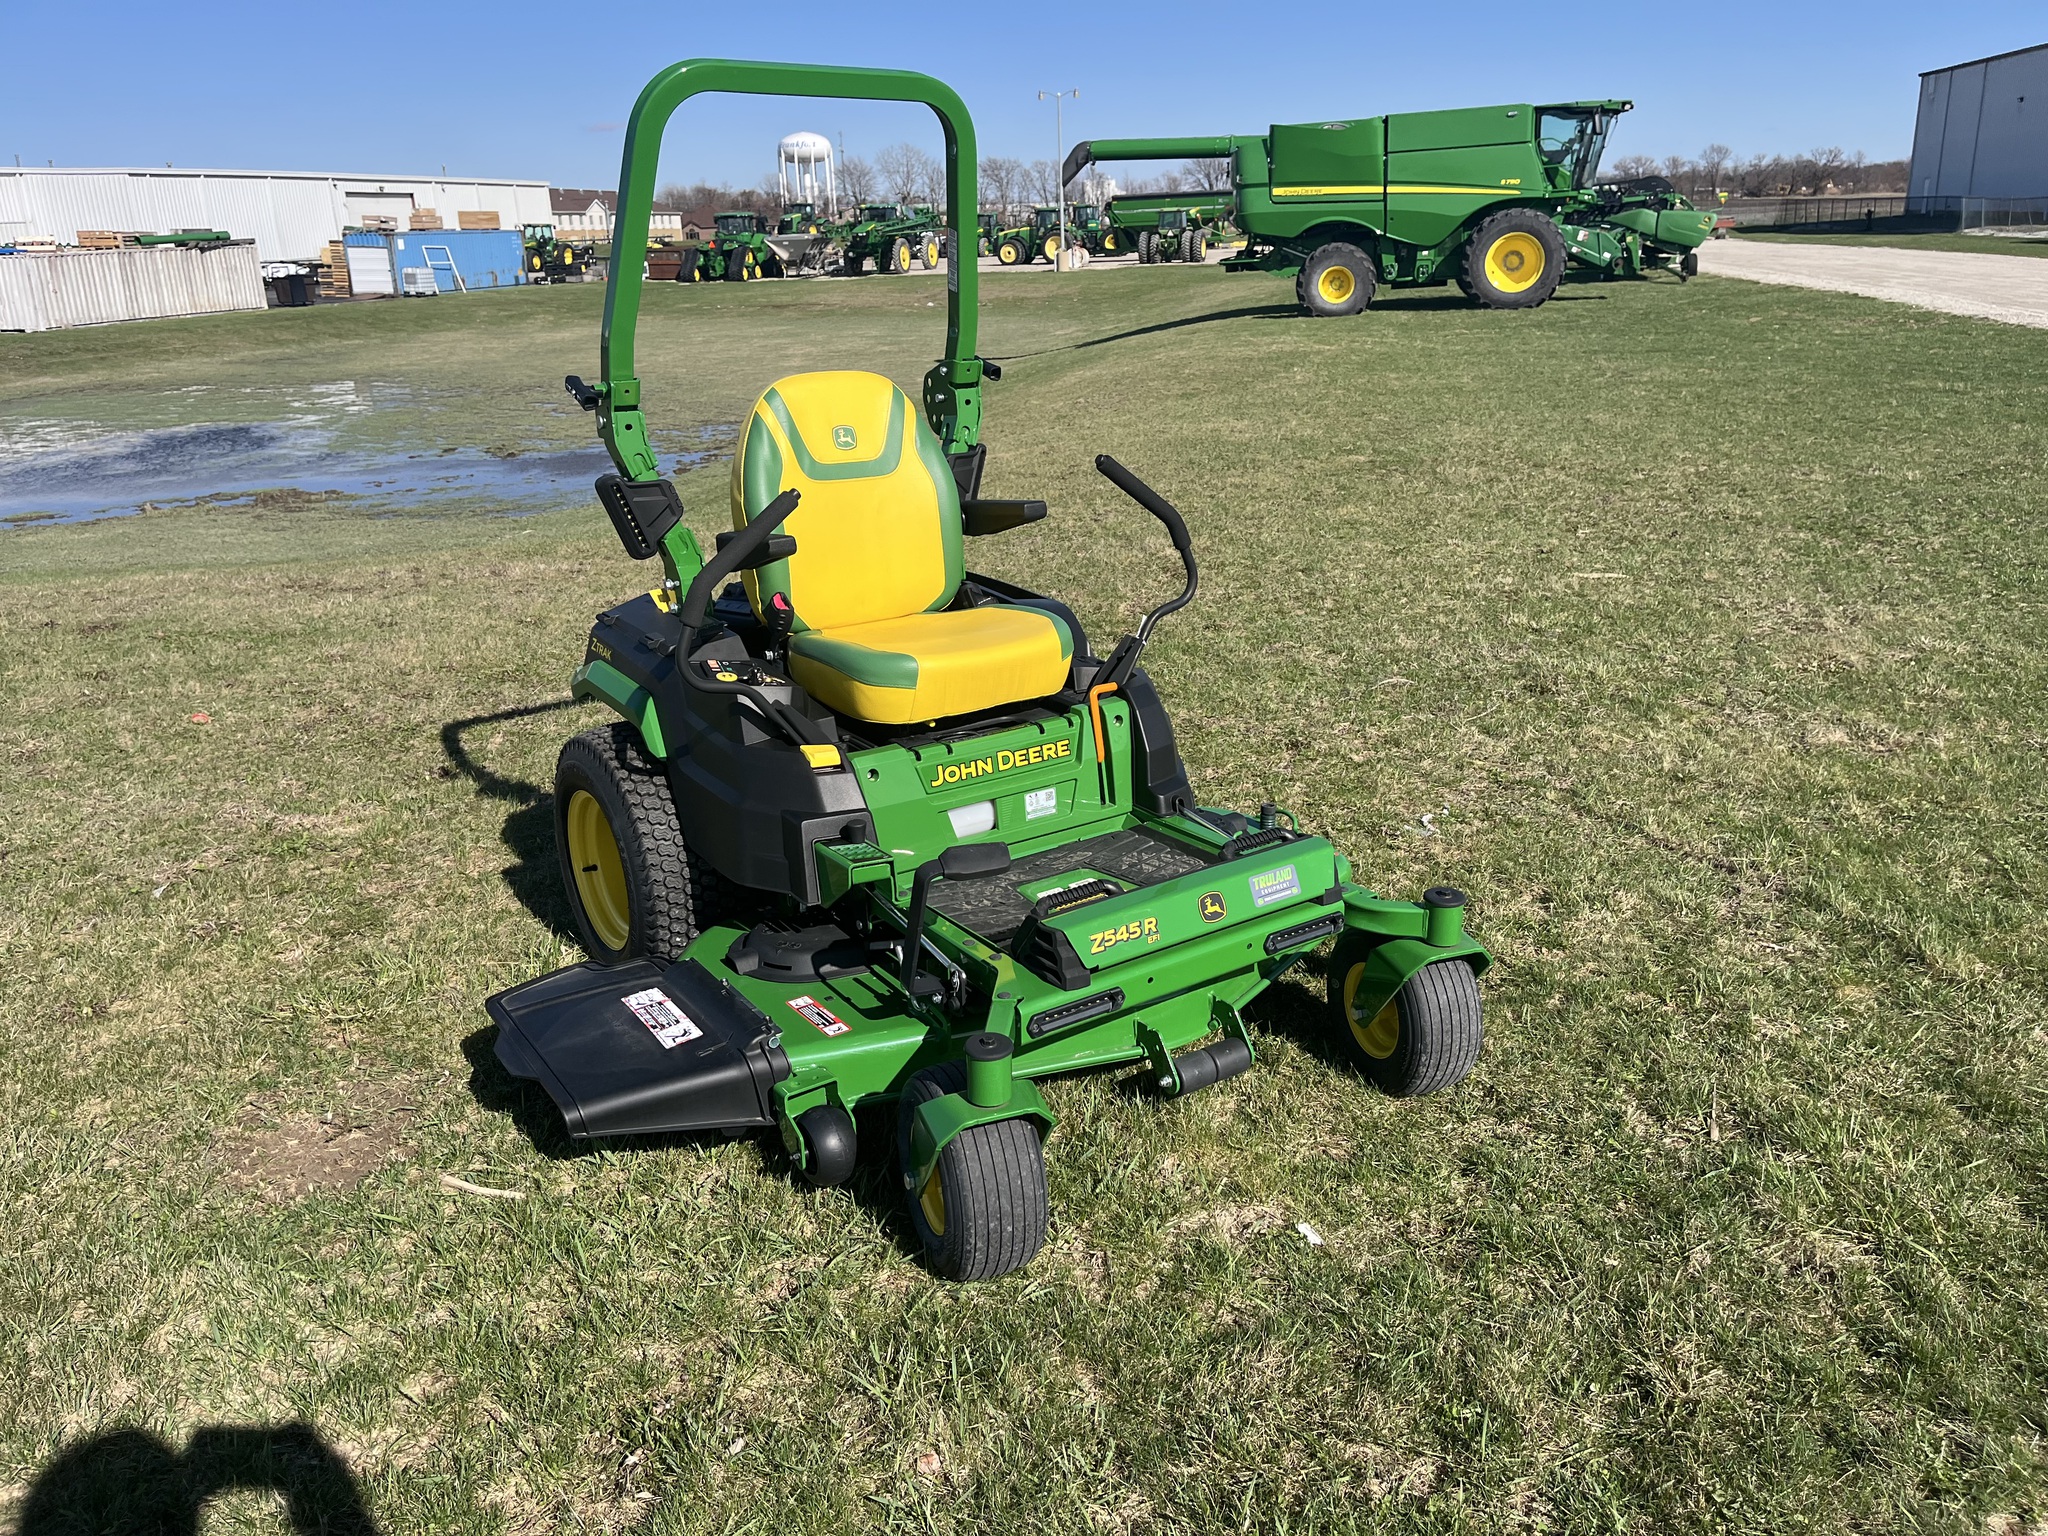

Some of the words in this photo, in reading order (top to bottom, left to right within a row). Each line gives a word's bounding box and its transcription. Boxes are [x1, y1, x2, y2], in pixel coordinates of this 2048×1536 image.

[780, 140, 816, 149] Frankfot
[591, 637, 612, 660] ZTRAK
[931, 756, 994, 787] JOHN
[996, 738, 1071, 772] DEERE
[1253, 867, 1292, 890] TRULAND
[1261, 881, 1290, 895] EQUIPMENT
[1089, 920, 1143, 955] Z545
[1144, 917, 1158, 935] R
[1147, 934, 1160, 944] EFI
